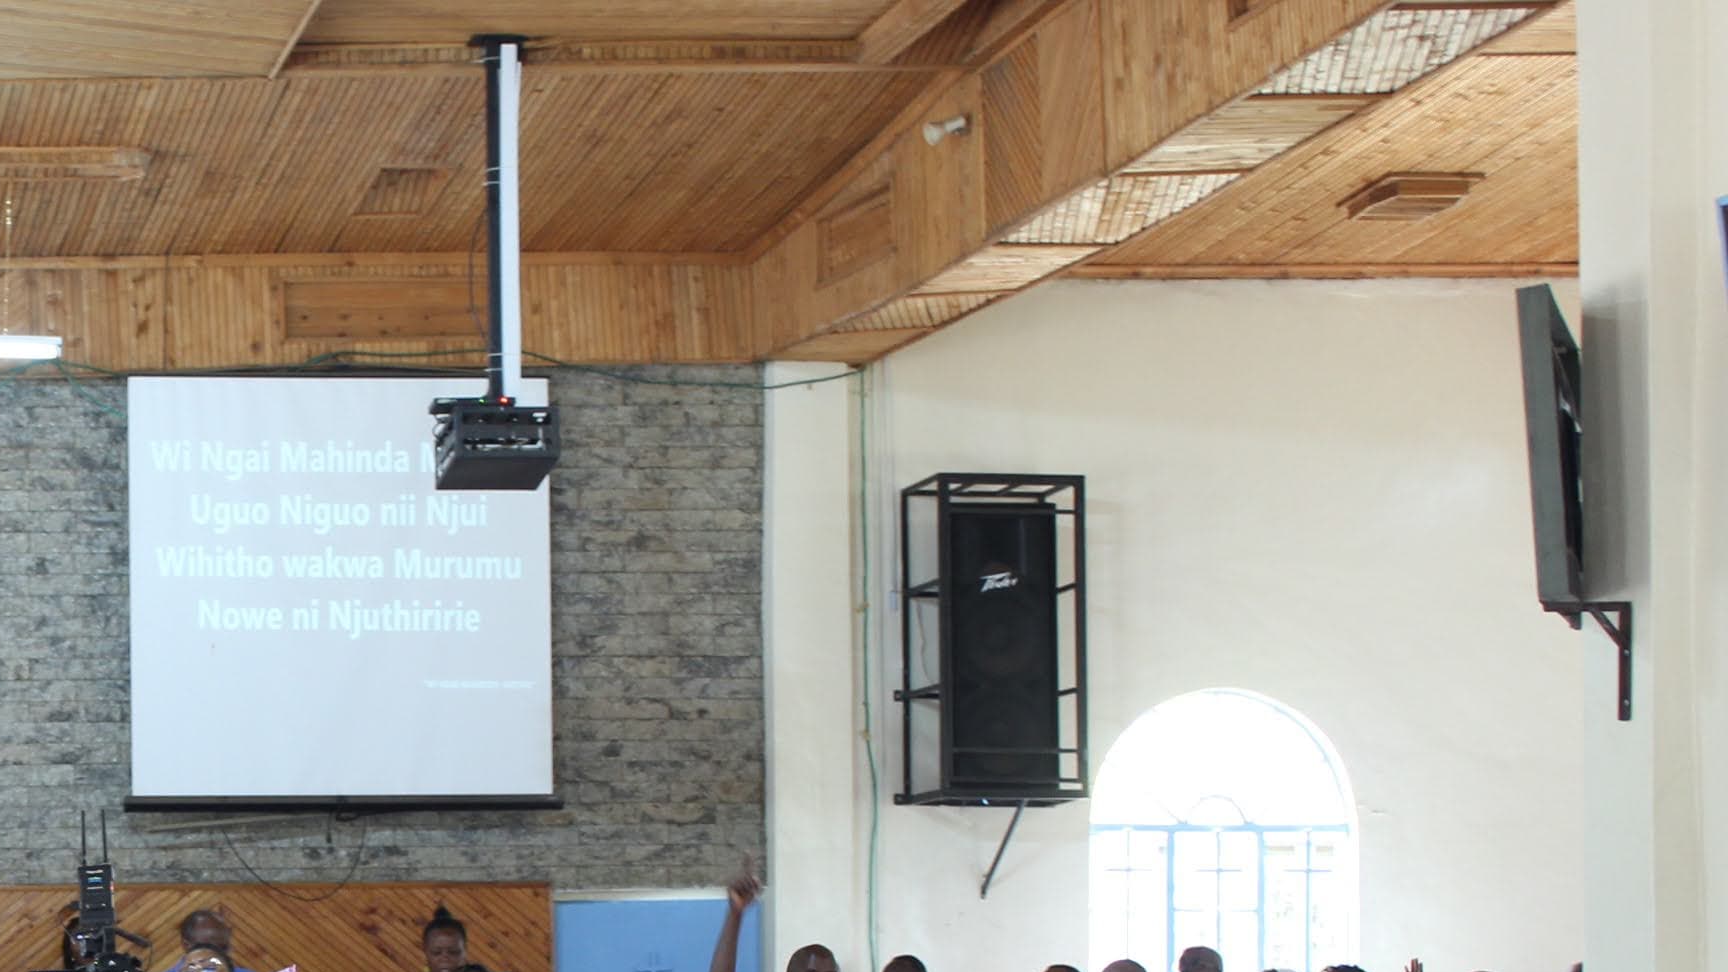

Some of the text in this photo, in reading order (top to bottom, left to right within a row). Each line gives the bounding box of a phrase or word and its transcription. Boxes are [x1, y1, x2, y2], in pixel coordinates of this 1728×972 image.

[150, 440, 191, 472] Wi
[201, 440, 270, 480] Ngai
[280, 440, 410, 472] Mahinda
[191, 493, 488, 534] Uguo Niguo nii Njui
[155, 546, 522, 580] Wihitho wakwa Murumu
[198, 599, 481, 639] Nowe ni Njuthiririe
